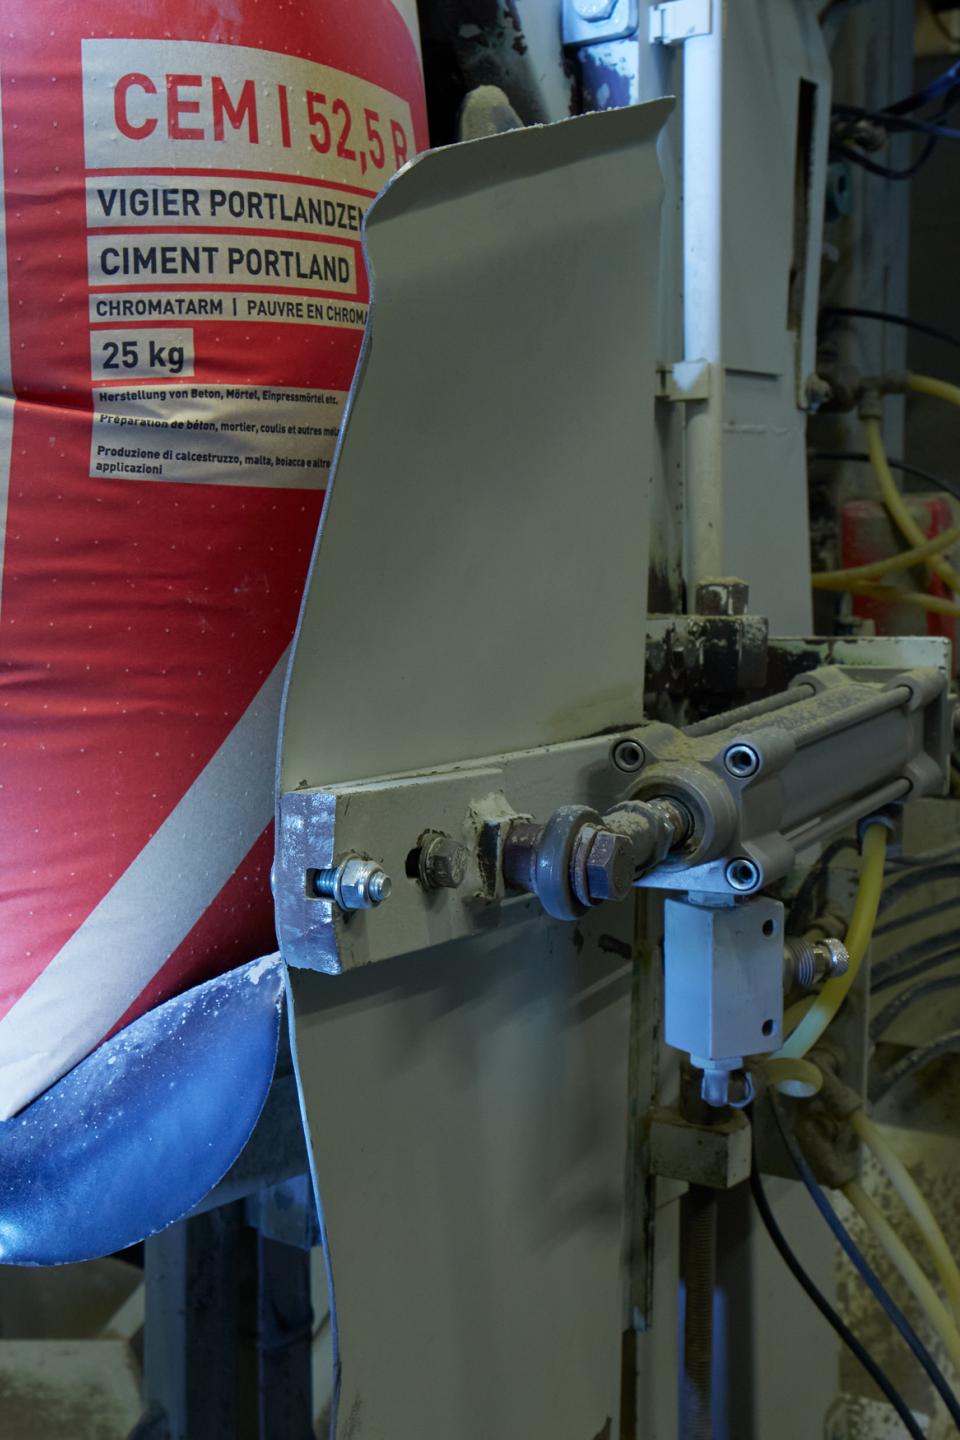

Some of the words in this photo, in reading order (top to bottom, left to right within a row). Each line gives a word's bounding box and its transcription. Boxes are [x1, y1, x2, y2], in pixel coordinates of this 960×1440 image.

[113, 72, 260, 145] CEM
[278, 84, 293, 148] I
[306, 90, 385, 176] 52,5
[390, 118, 408, 171] R
[96, 188, 202, 217] VIGIER
[100, 246, 219, 275] CIMENT
[227, 247, 350, 284] PORTLAND
[96, 298, 223, 317] CHROMATARM
[247, 299, 304, 319] PAUVRE
[306, 303, 324, 320] EN
[101, 342, 139, 369] 25
[149, 340, 185, 373] kg
[98, 390, 167, 403] Herstellung
[168, 389, 189, 399] von
[190, 388, 224, 401] Beton,
[226, 388, 261, 402] Mörtel,
[262, 390, 325, 405] Einpressmörtel
[325, 396, 339, 405] etc.
[170, 420, 184, 430] de
[186, 418, 219, 432] béton,
[220, 421, 258, 434] mortier,
[260, 424, 286, 434] coulis
[287, 424, 297, 435] et
[297, 425, 322, 436] autres
[97, 445, 160, 460] Produzione
[162, 449, 173, 461] di
[175, 451, 242, 466] calcestruzzo,
[244, 455, 274, 467] malta,
[96, 461, 163, 475] applicazioni
